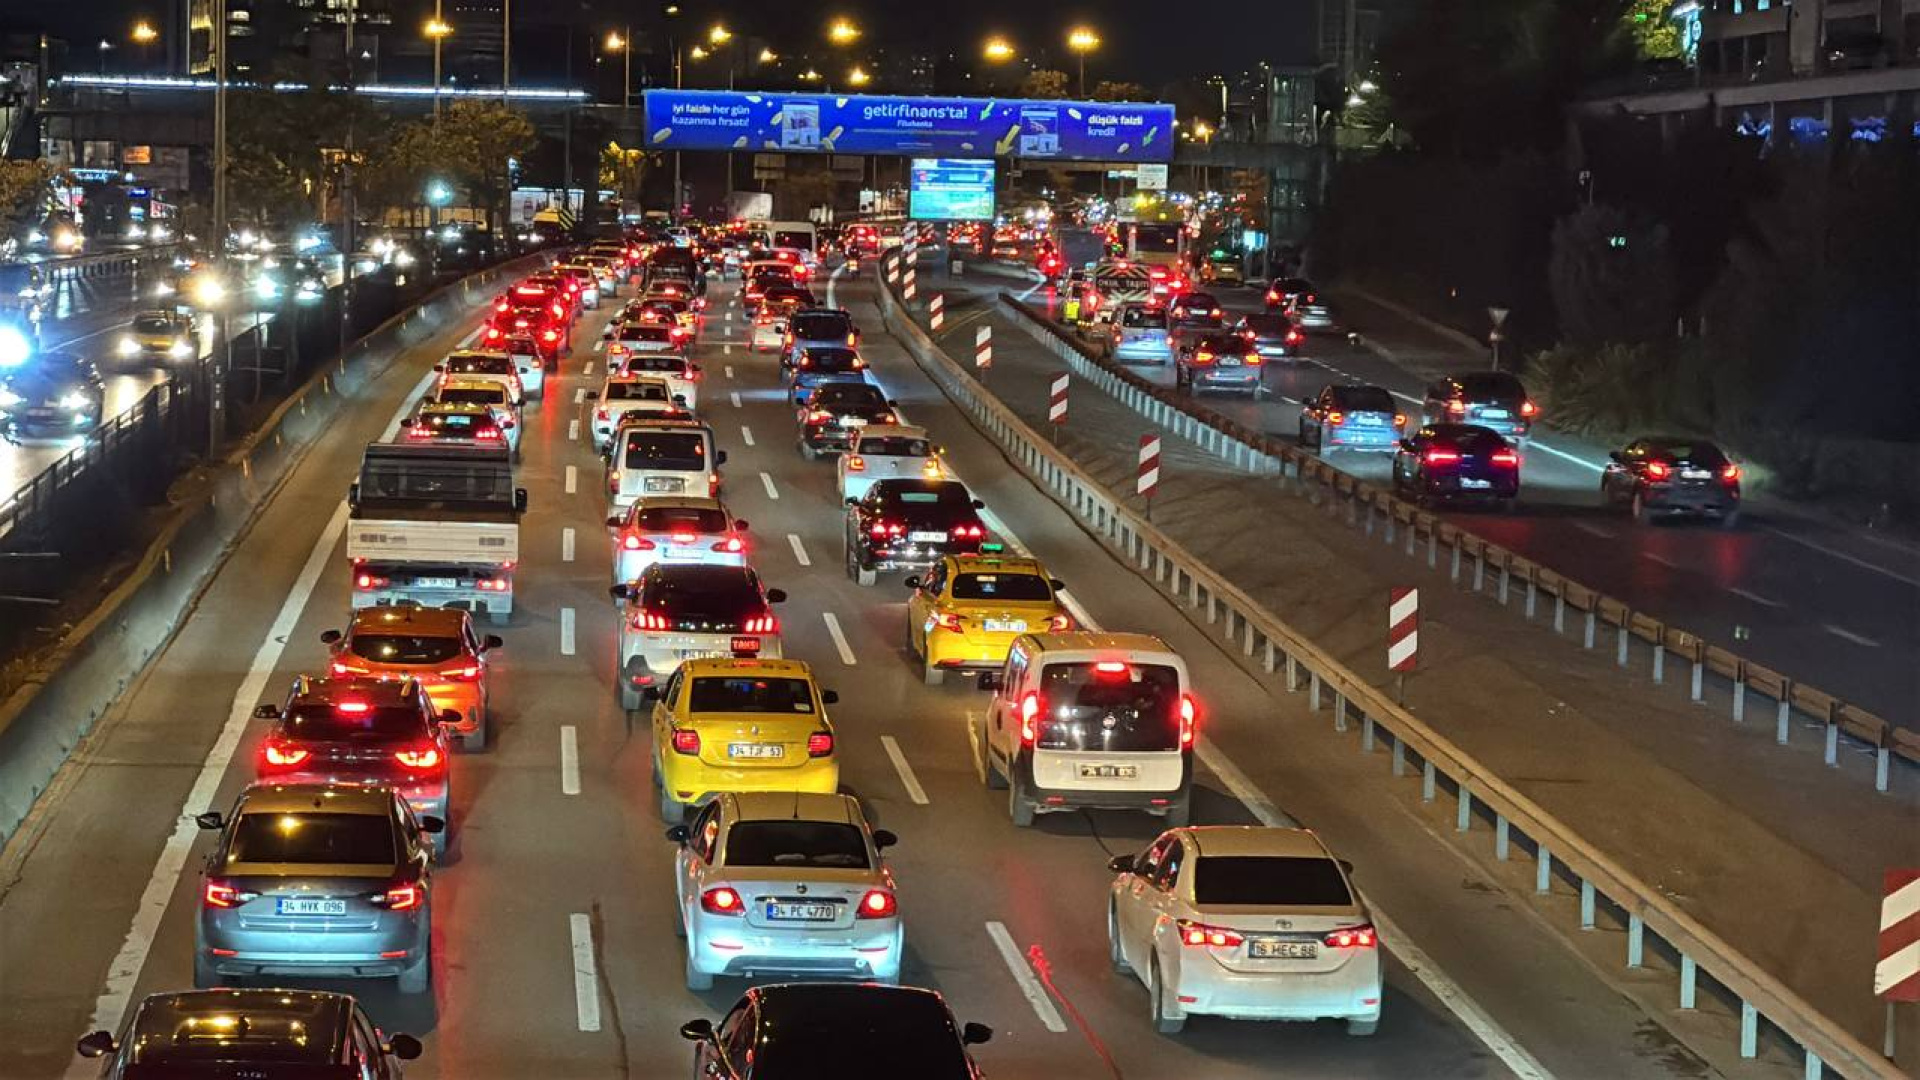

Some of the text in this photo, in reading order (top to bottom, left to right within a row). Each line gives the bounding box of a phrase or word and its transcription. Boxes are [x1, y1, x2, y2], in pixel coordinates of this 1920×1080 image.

[673, 104, 750, 117] iyi faizle her gün
[672, 116, 717, 126] kazanma
[1088, 115, 1143, 127] düşük faizli
[284, 902, 295, 912] 34
[773, 905, 785, 915] 34
